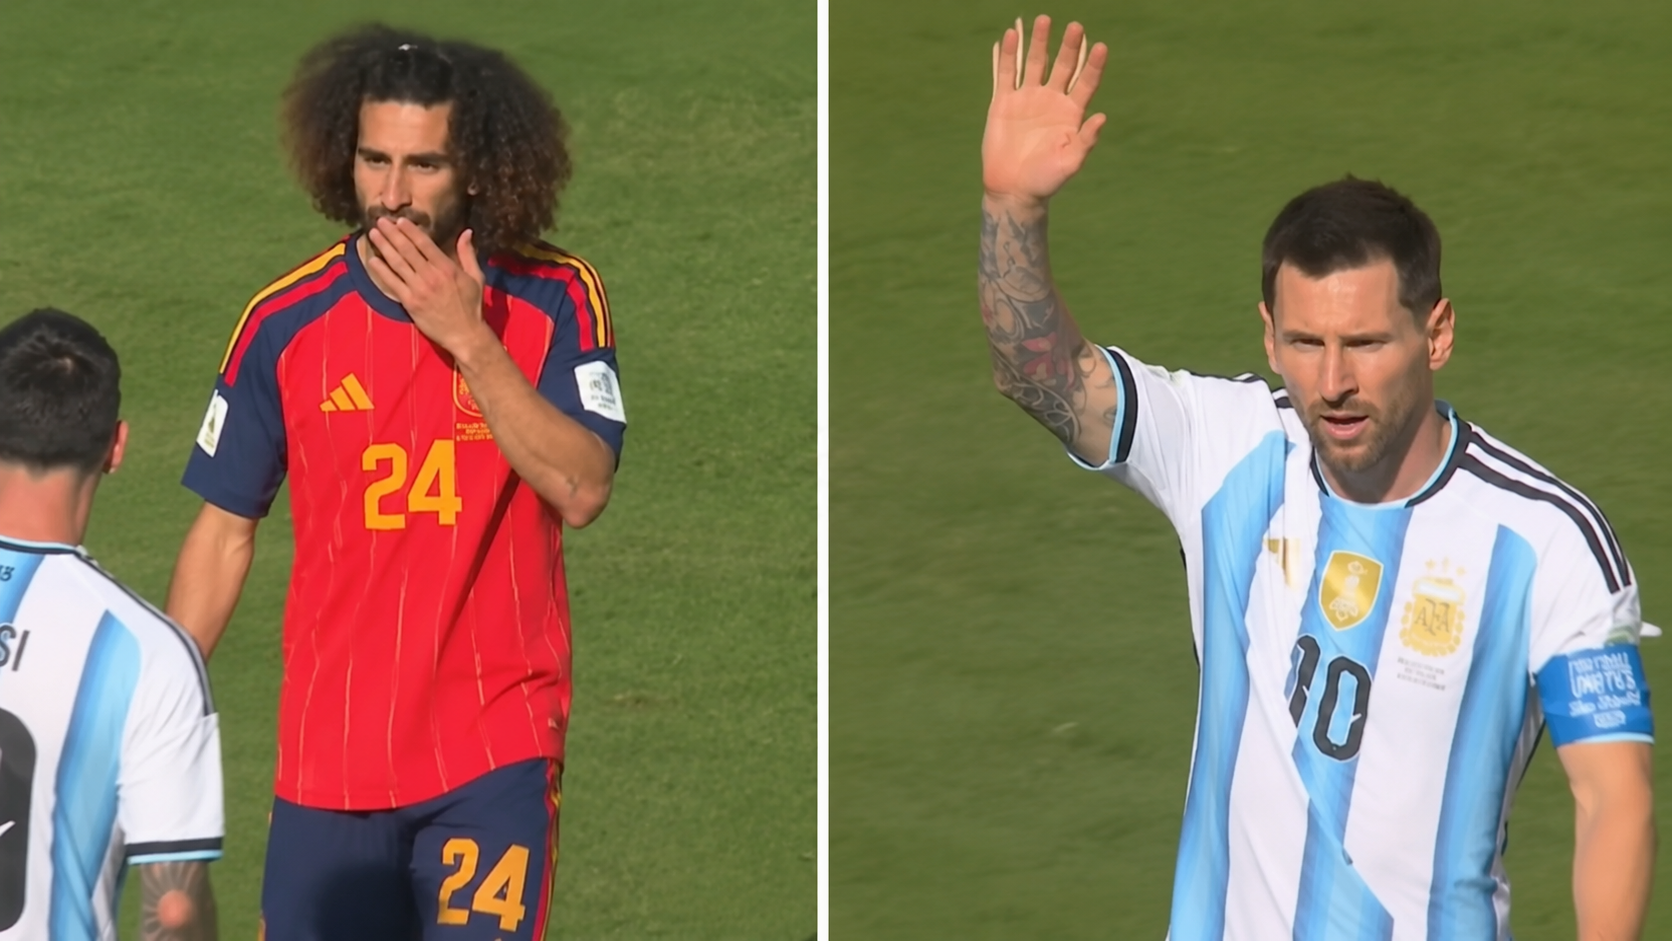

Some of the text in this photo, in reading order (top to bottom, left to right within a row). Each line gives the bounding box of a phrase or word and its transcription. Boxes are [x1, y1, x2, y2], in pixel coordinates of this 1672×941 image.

[362, 439, 462, 530] 24
[1289, 634, 1371, 761] 10
[437, 838, 529, 932] 24
